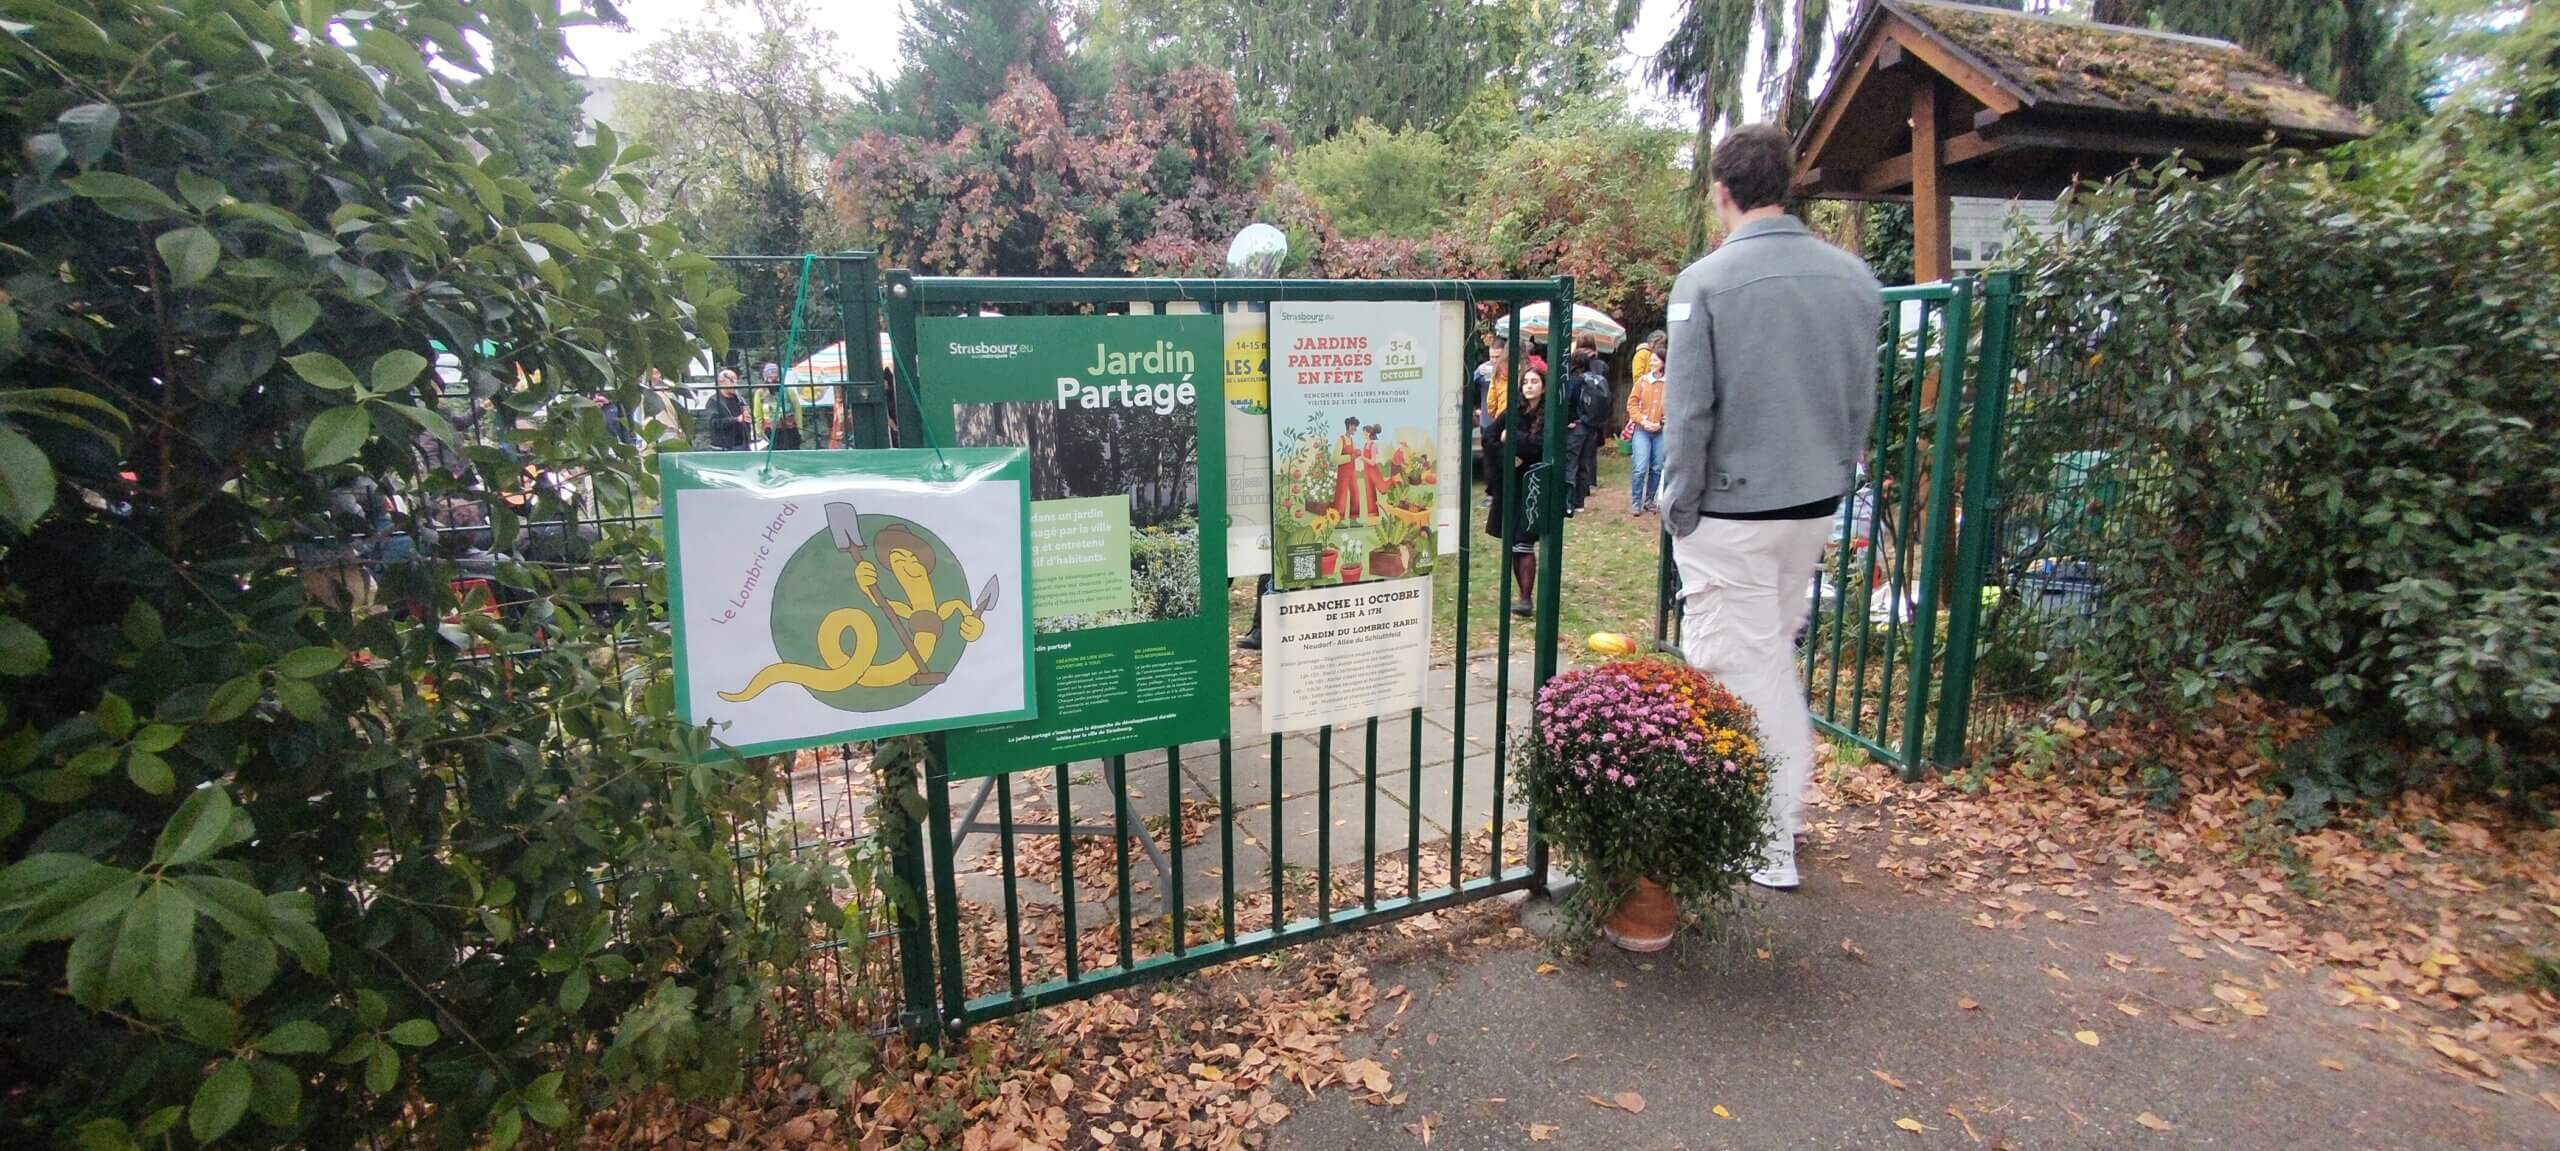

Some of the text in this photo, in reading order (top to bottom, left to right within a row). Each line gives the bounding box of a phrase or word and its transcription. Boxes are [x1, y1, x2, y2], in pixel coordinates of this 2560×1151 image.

[949, 341, 1034, 358] Strasbourg.eu
[1236, 341, 1260, 350] 14-15
[1293, 336, 1368, 350] JARDINS
[1390, 340, 1412, 352] 3-4
[1088, 340, 1195, 376] Jardin
[1287, 349, 1373, 368] PARTAGÉS
[1385, 354, 1416, 366] 10-11
[1225, 359, 1252, 375] LES
[1382, 369, 1421, 379] OCTOBRE
[1297, 367, 1364, 385] EN FÊTE
[1057, 374, 1196, 415] Partagé
[1031, 512, 1056, 521] dans
[1073, 508, 1103, 521] jardin
[1060, 528, 1077, 538] par
[1080, 523, 1088, 534] la
[1091, 520, 1112, 533] ville
[1055, 539, 1104, 551] entretenu
[711, 500, 800, 625] Le Lombric Hardi
[1279, 589, 1420, 616] DIMANCHE 11 OCTOBRE
[1326, 613, 1338, 621] DE
[1340, 611, 1356, 620] 13H
[1367, 607, 1382, 616] 17H
[1281, 618, 1418, 644] AU JARDIN DU LOMBRIC HARDI
[1047, 642, 1072, 652] partagé
[1303, 640, 1332, 651] Neudorf
